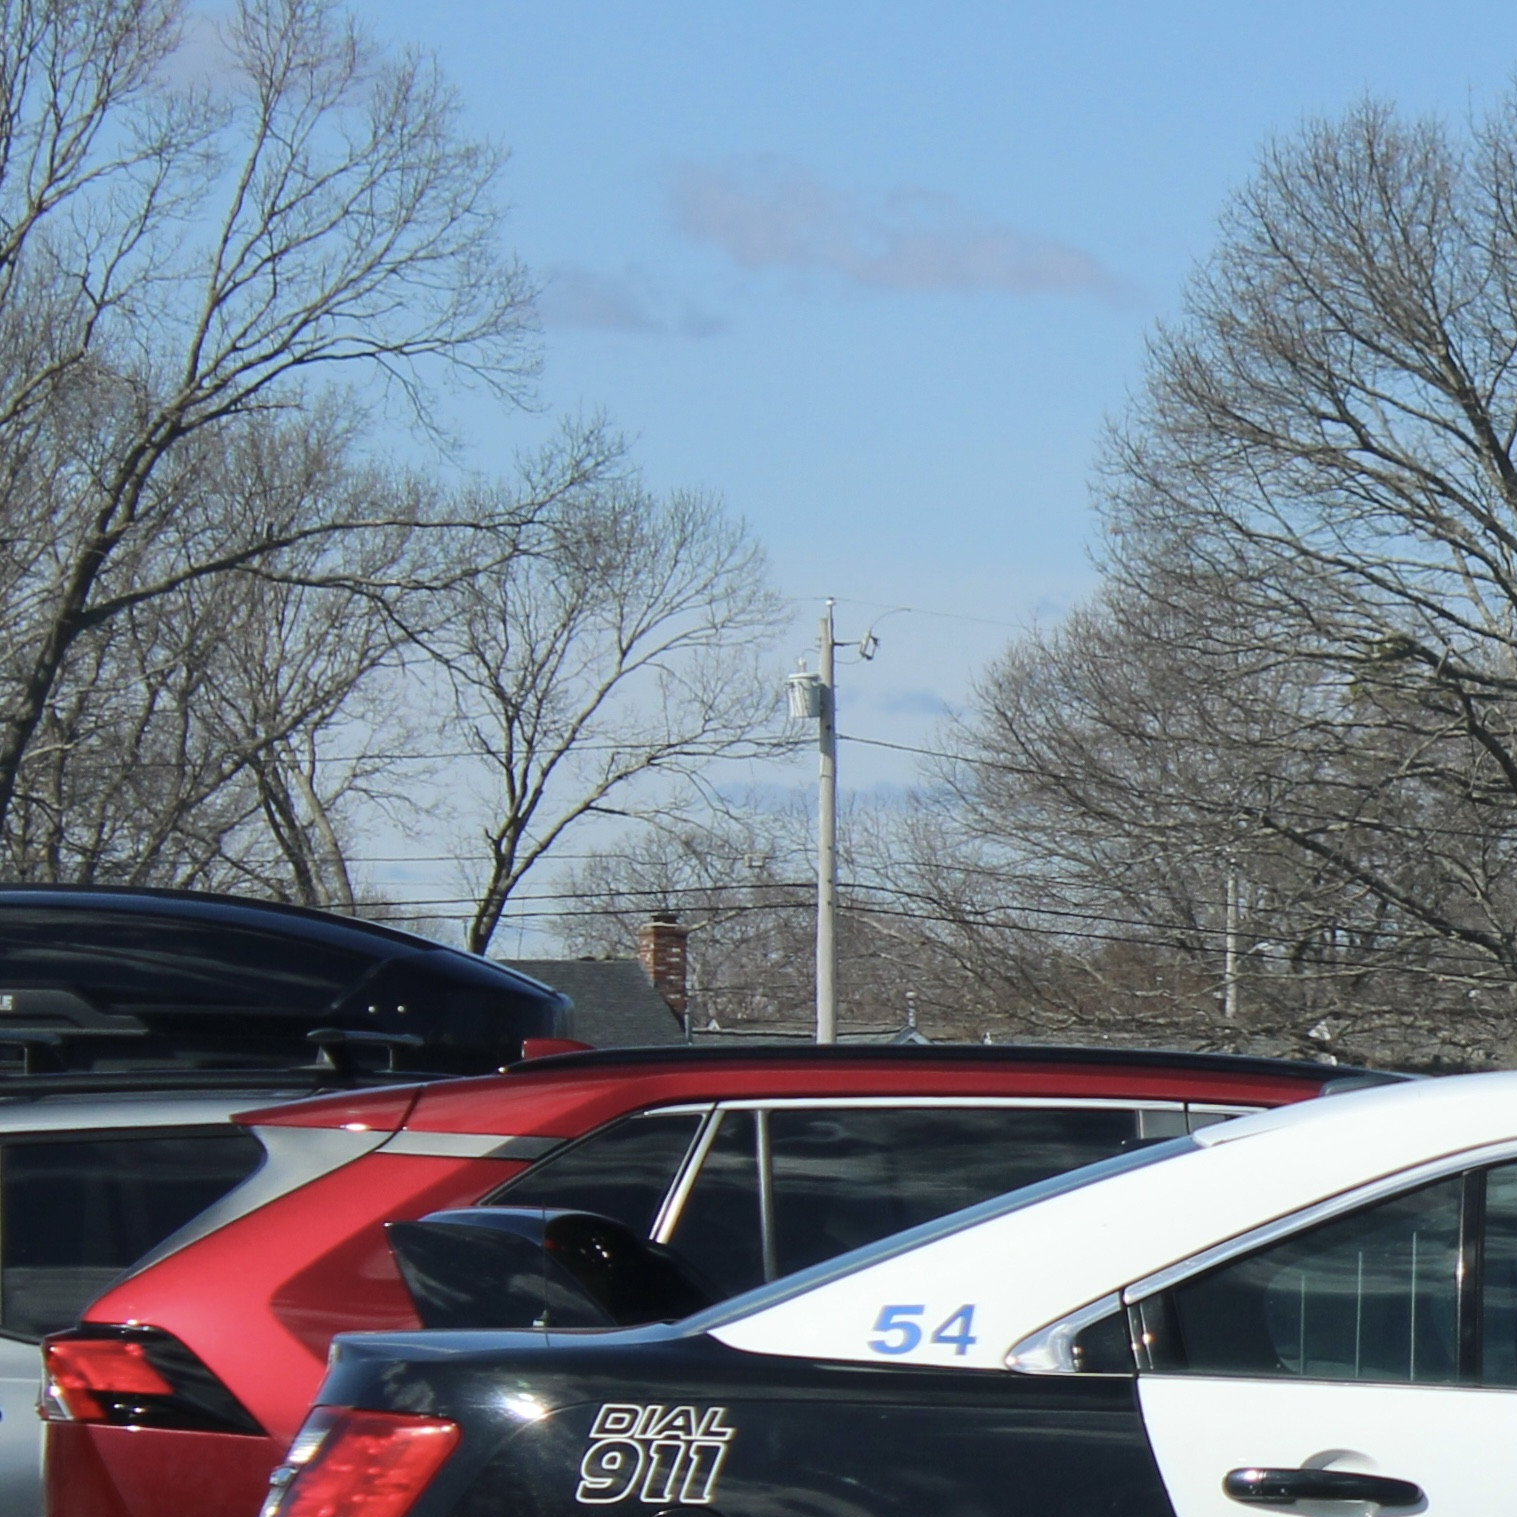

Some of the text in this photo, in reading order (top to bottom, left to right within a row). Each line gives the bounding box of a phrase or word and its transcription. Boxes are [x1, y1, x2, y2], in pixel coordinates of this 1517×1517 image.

[868, 1304, 978, 1356] 54
[590, 1404, 736, 1441] DIAL
[576, 1438, 729, 1504] 911
